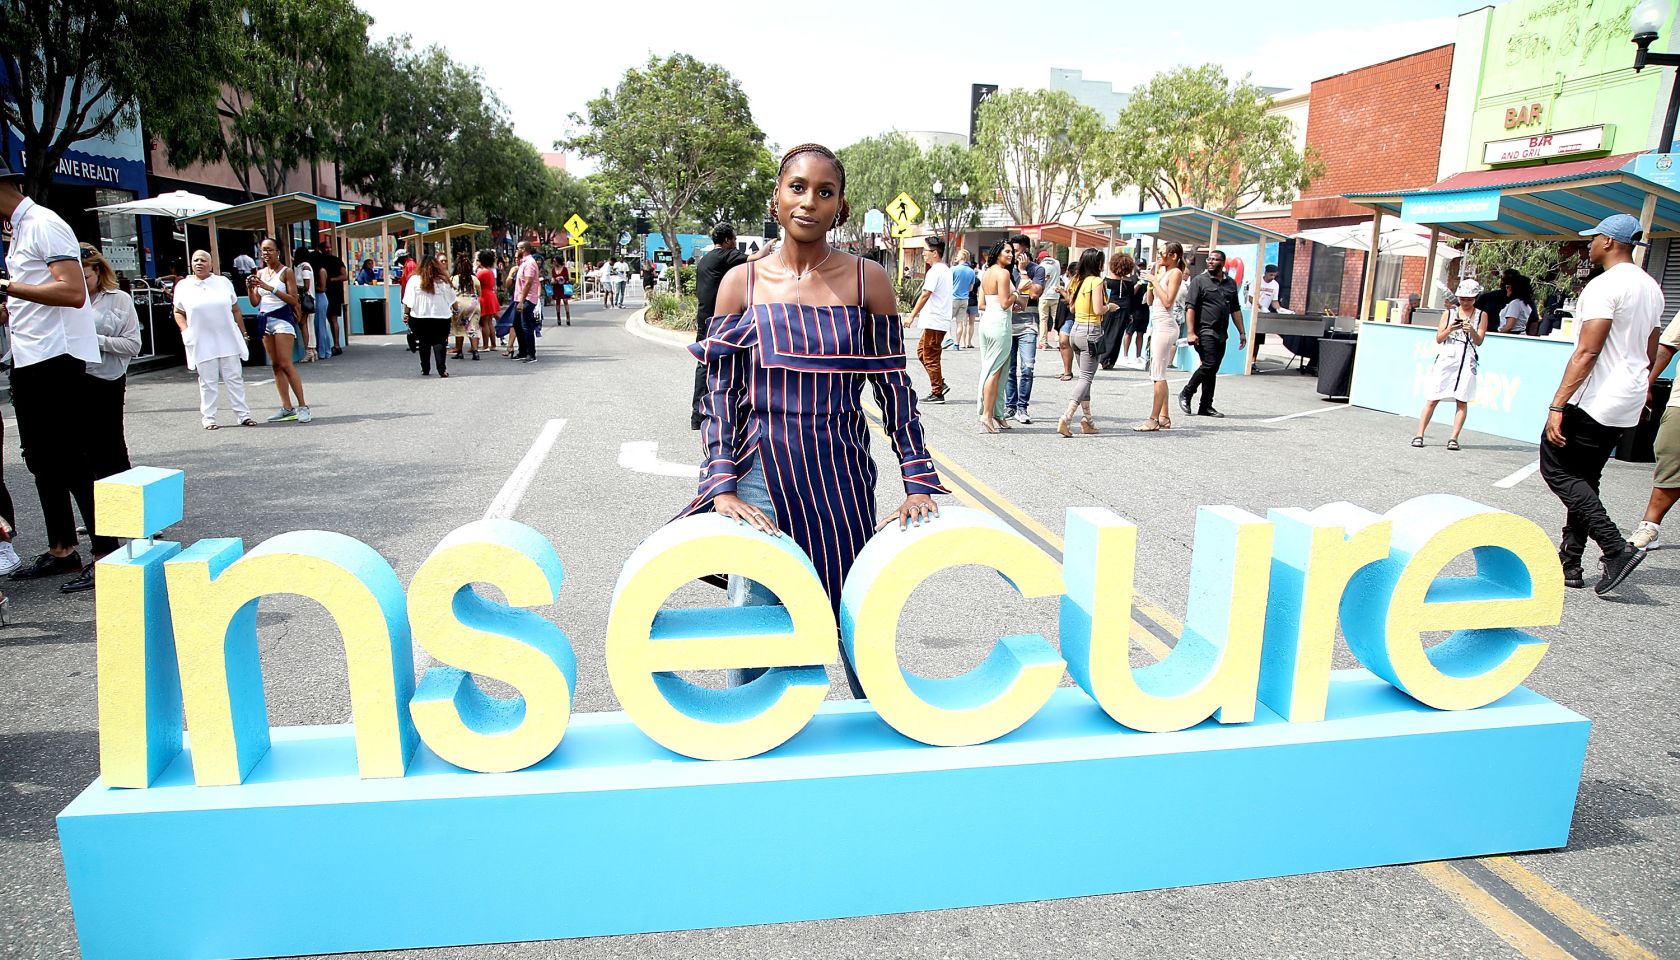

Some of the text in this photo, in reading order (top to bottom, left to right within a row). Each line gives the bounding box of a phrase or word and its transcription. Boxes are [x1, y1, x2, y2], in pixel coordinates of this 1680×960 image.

[1504, 103, 1543, 130] BAR
[1529, 135, 1553, 148] BAR
[1500, 151, 1520, 161] AND
[82, 162, 119, 183] REALTY
[94, 466, 1565, 789] insecure
